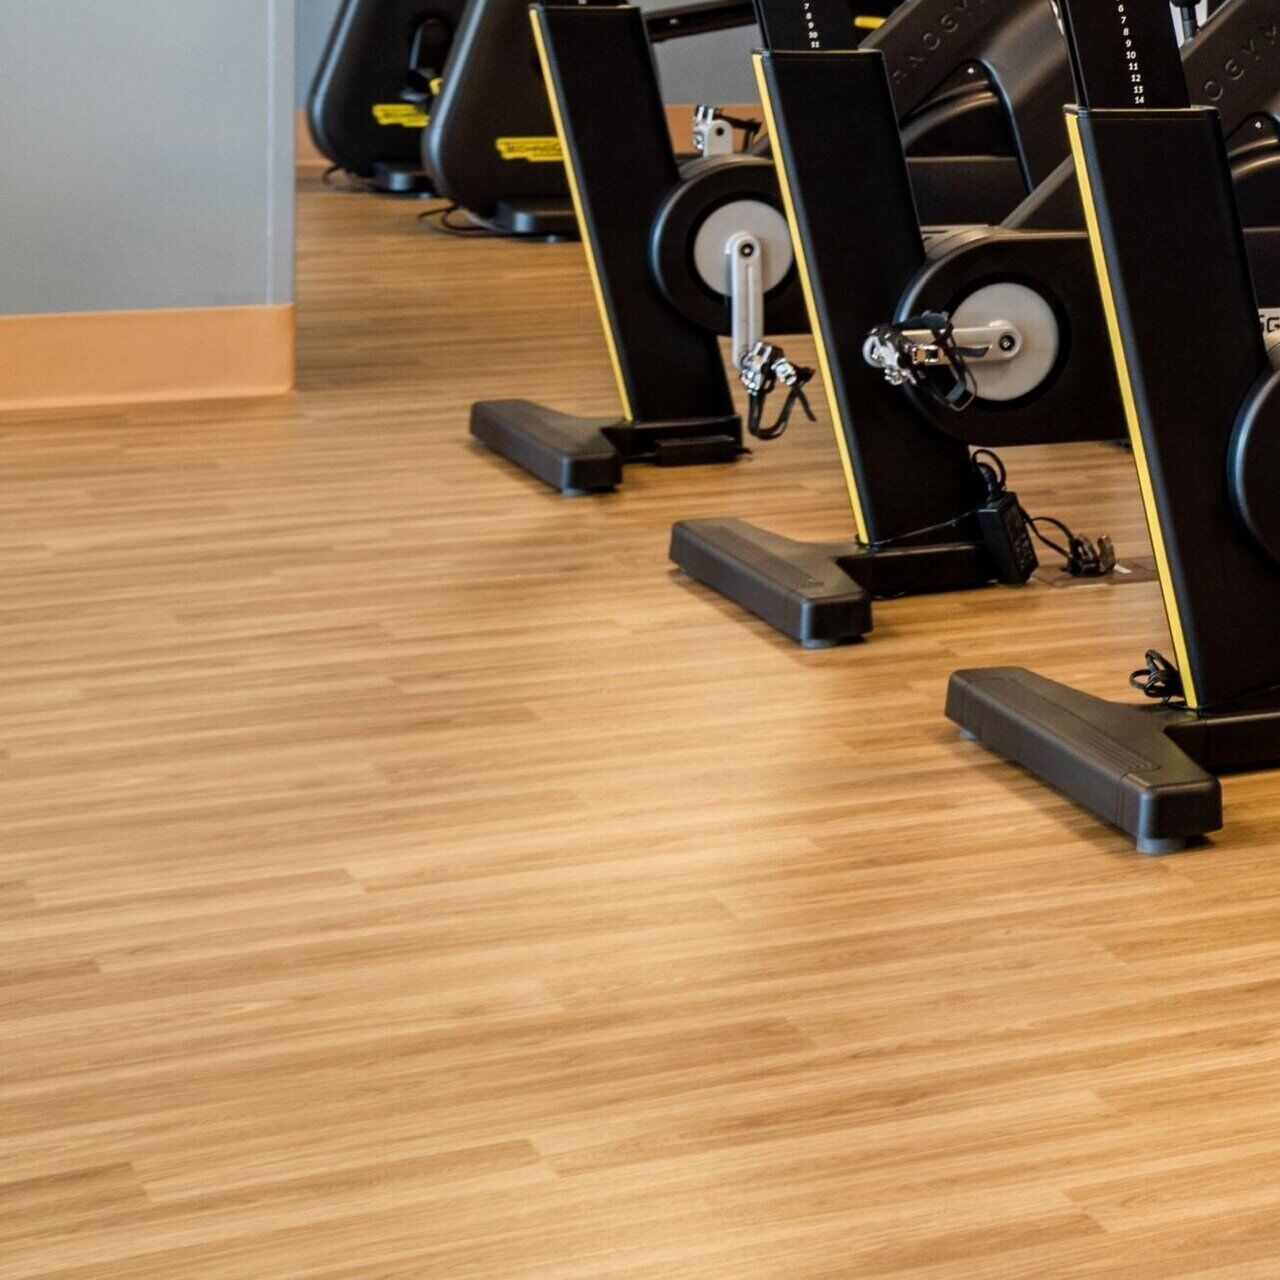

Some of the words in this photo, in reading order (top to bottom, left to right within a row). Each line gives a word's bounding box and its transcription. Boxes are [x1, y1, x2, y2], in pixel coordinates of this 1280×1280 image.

[1118, 4, 1124, 12] 6
[1121, 16, 1126, 24] 7
[1123, 28, 1129, 36] 8
[1126, 39, 1131, 47] 9
[1126, 51, 1136, 59] 10
[1129, 62, 1138, 70] 11
[1131, 74, 1141, 82] 12
[1135, 96, 1144, 104] 14
